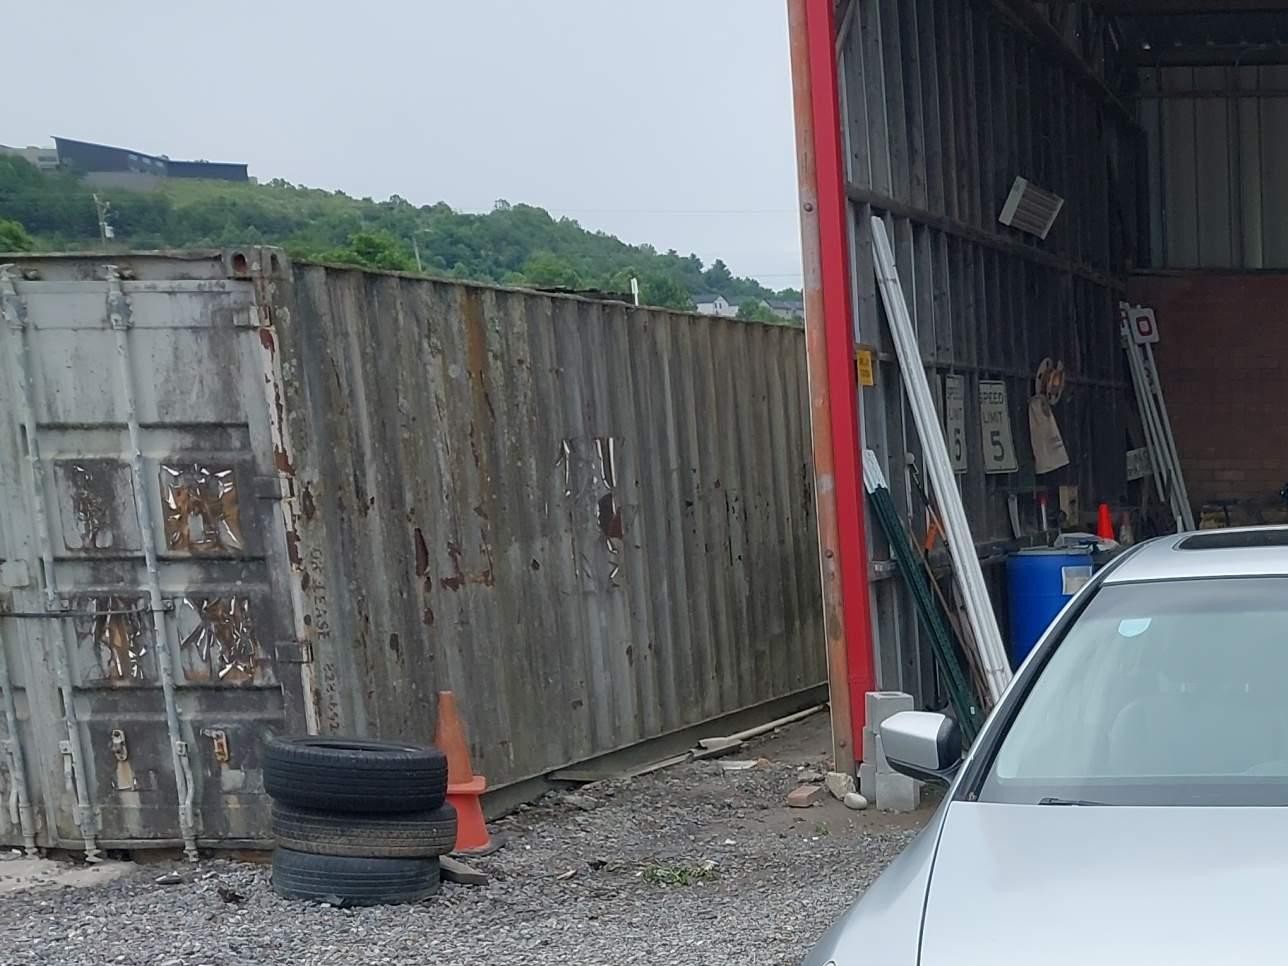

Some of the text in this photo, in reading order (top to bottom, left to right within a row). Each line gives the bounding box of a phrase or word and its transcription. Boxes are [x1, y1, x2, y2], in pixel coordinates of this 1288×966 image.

[979, 391, 1003, 404] SPEED
[983, 411, 1003, 424] LIMIT
[954, 428, 962, 462] 5
[990, 430, 1005, 462] 5
